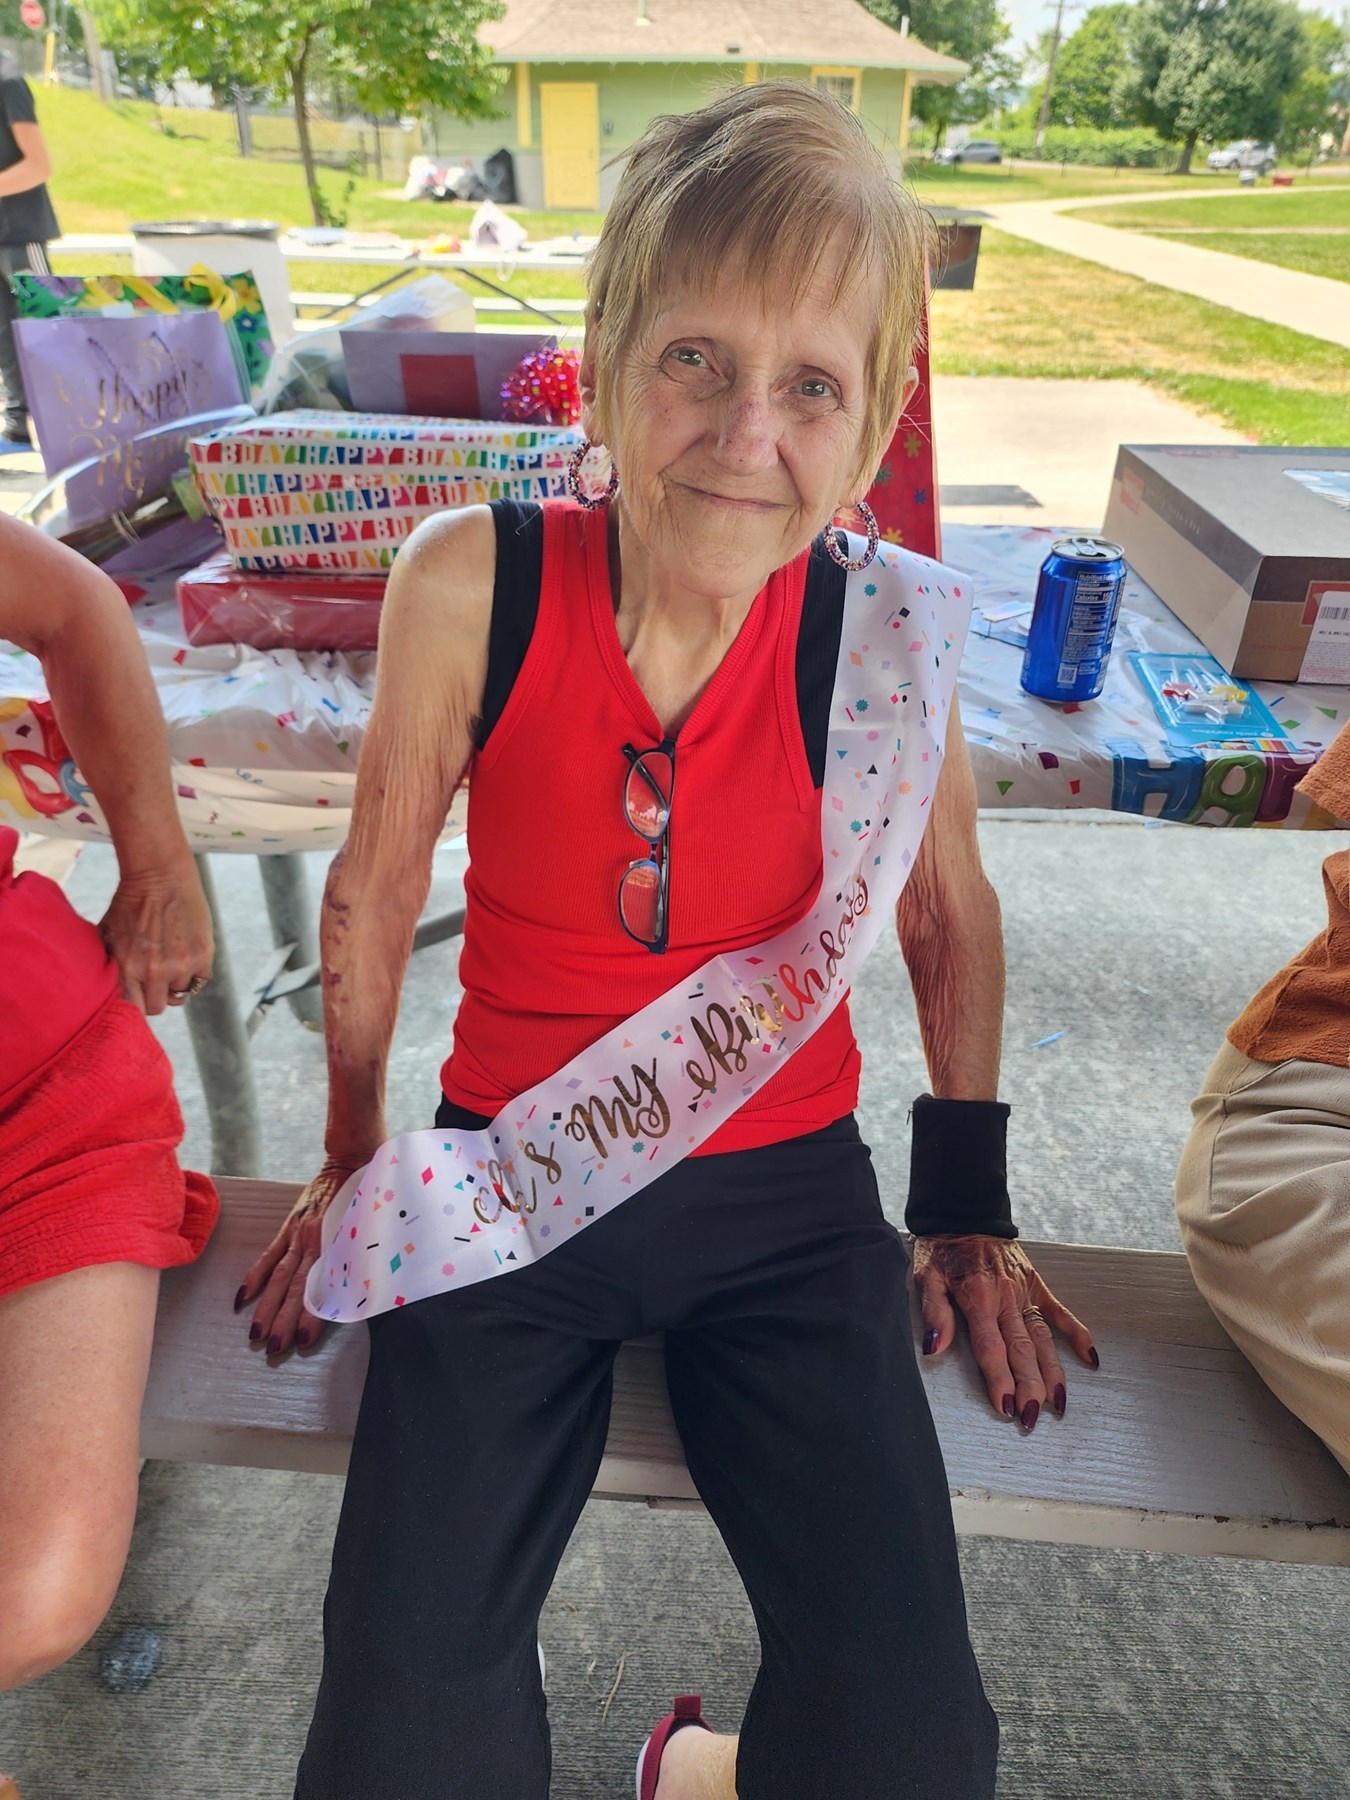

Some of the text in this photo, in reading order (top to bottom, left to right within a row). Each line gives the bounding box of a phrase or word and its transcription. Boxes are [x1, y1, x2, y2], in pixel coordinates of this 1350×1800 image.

[306, 445, 394, 466] HAPPY
[332, 486, 416, 513] HAPPY
[280, 521, 363, 547] HAPPY
[565, 1057, 671, 1159] My
[686, 860, 869, 1100] Birthday
